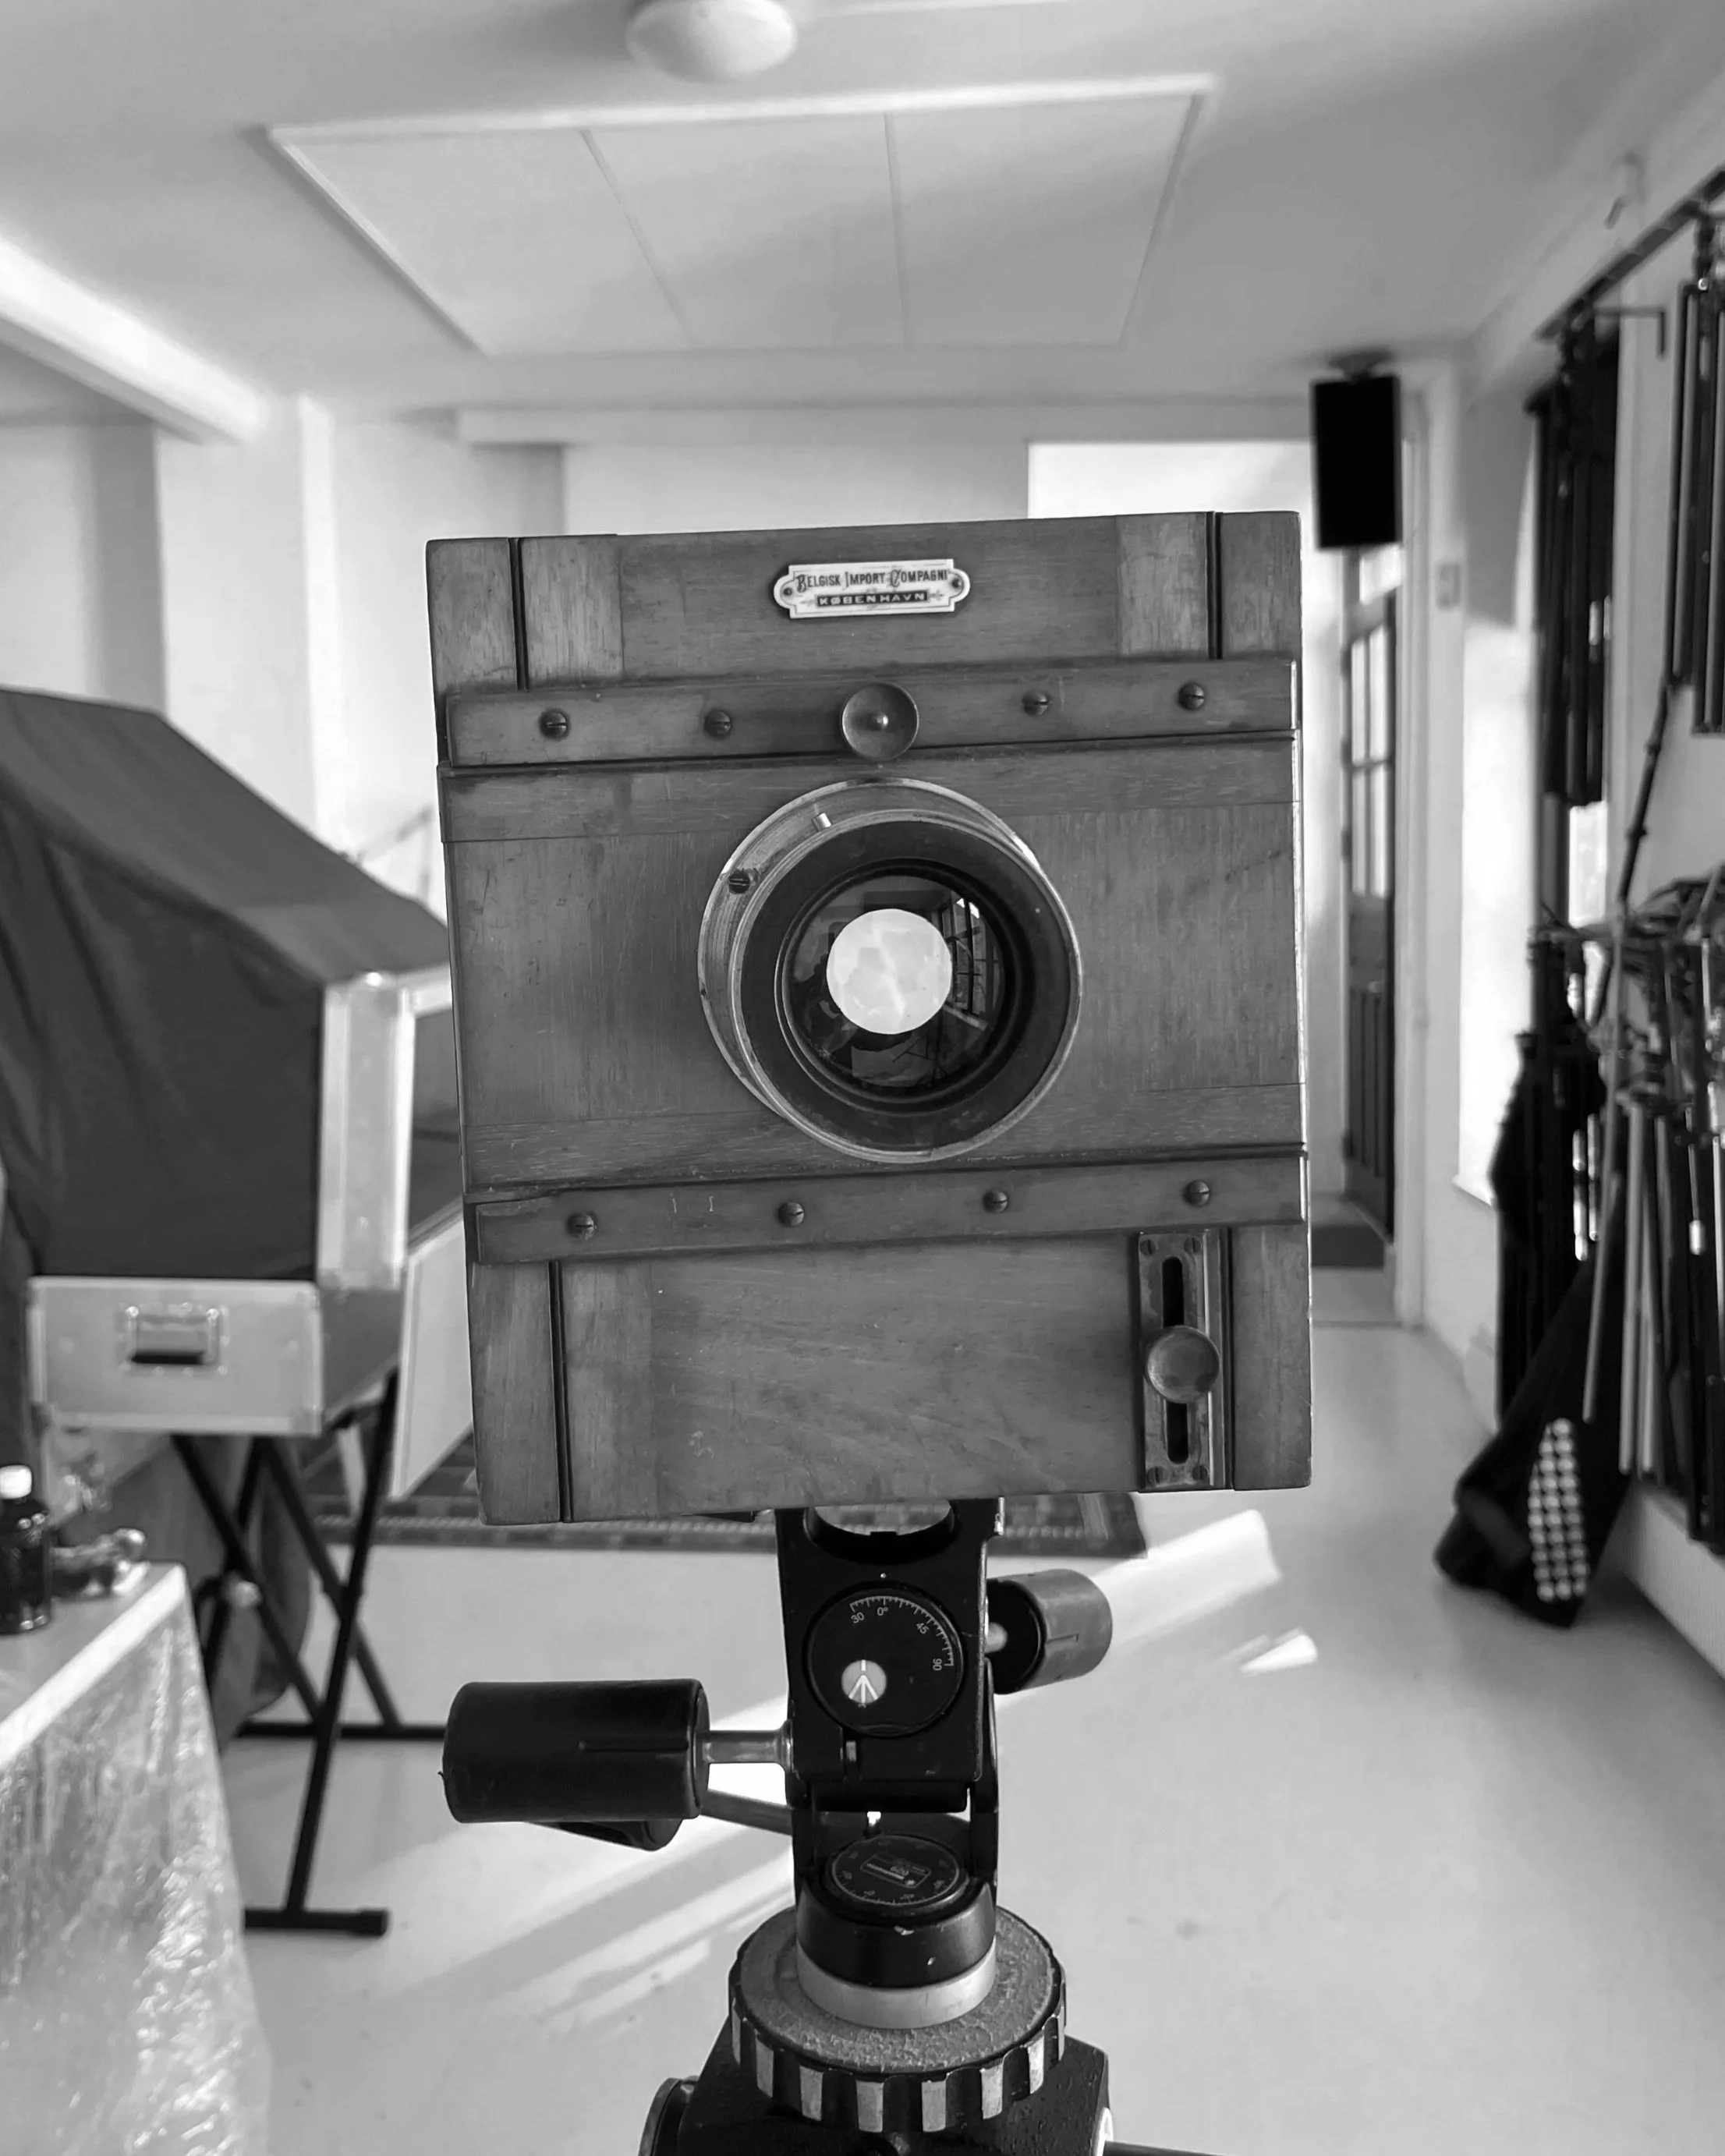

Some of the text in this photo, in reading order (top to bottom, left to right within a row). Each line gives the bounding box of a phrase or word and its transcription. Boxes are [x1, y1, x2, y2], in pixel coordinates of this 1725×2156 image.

[795, 569, 948, 593] BELGISK IMPORT COMPAGNI
[819, 593, 926, 606] KØBENHAVN
[851, 1612, 865, 1623] 30
[916, 1622, 930, 1634] 45
[933, 1658, 942, 1671] 90
